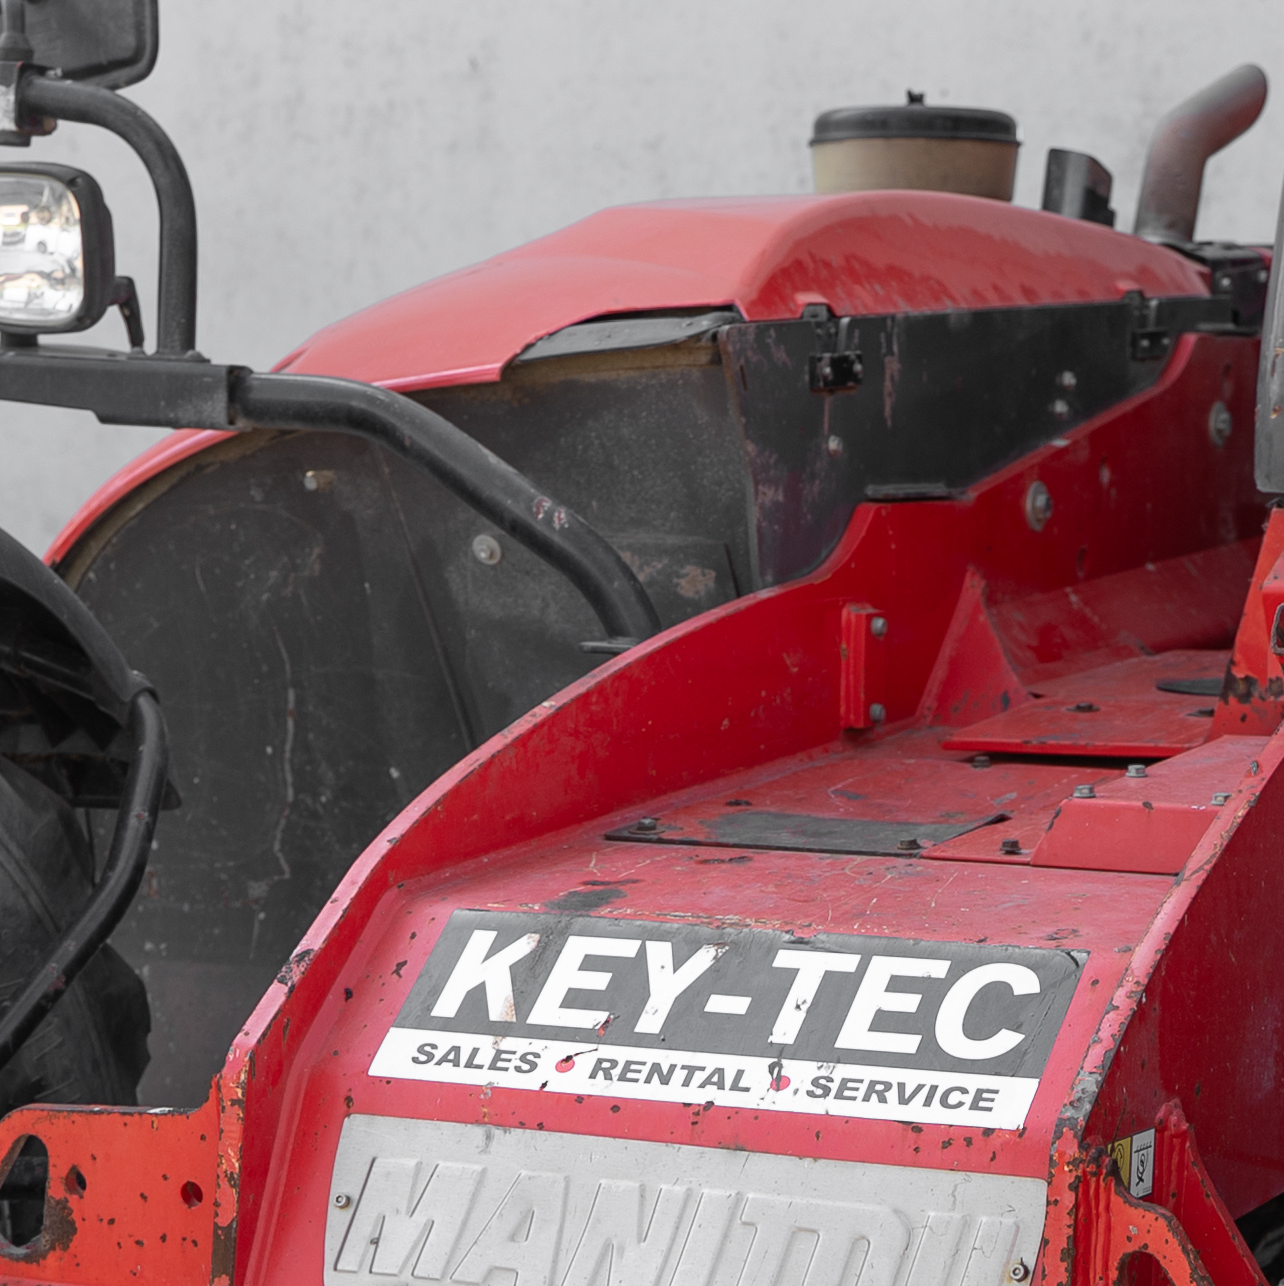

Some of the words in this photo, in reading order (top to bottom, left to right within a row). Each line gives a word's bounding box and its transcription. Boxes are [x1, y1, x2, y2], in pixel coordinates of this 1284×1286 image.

[431, 929, 1042, 1061] KEY-TEC
[410, 1042, 541, 1075] SALES
[588, 1056, 752, 1094] RENTAL
[804, 1075, 1000, 1113] SERVICE
